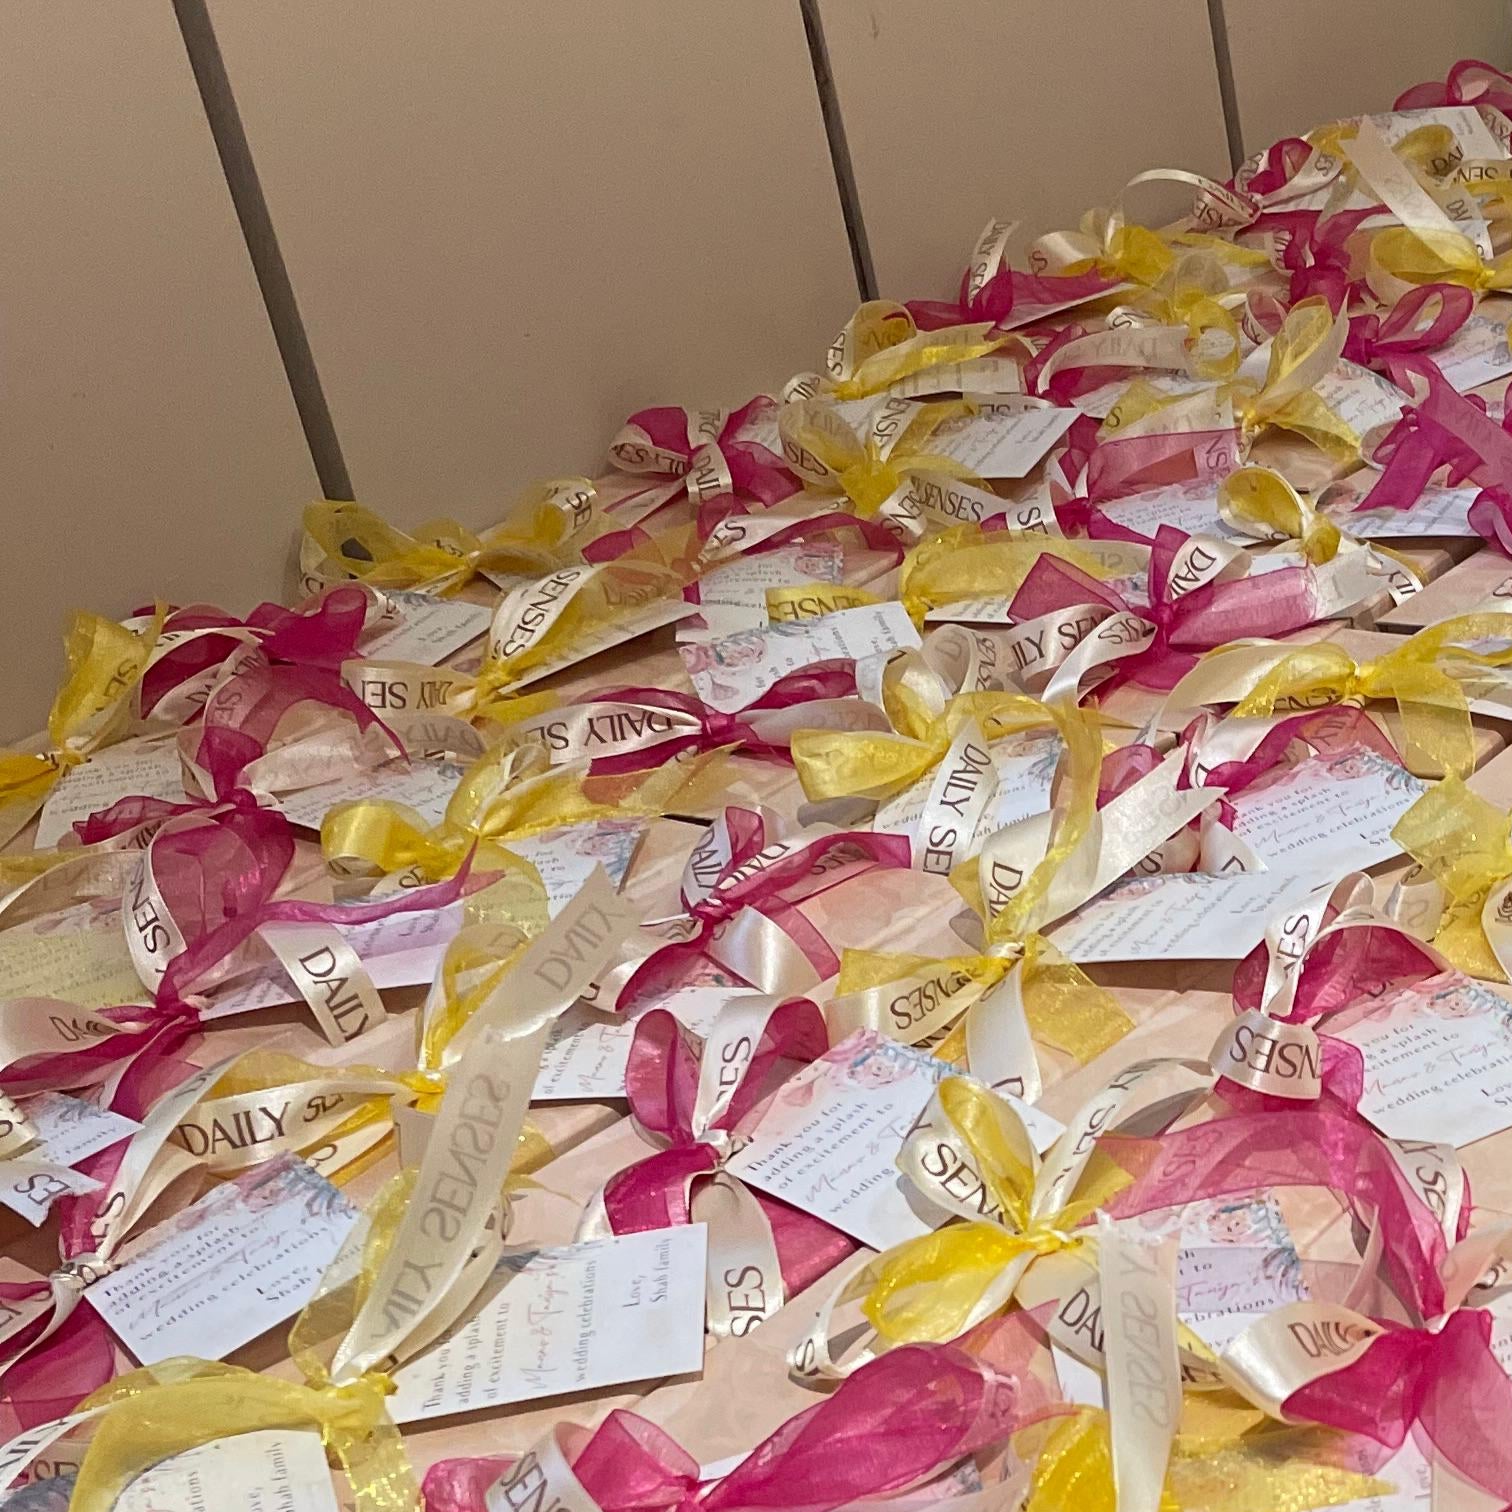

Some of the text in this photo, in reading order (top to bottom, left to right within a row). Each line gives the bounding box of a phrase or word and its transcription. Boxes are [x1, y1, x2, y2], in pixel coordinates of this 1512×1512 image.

[937, 742, 993, 819] DAILY
[179, 1101, 292, 1157] DAILY
[1373, 1084, 1443, 1115] wedding
[747, 1102, 843, 1172] Thank you for
[763, 1101, 869, 1183] adding splash
[778, 1102, 894, 1190] of excitement to
[828, 1166, 896, 1213] wedding
[622, 1274, 649, 1307] Love,
[649, 1237, 673, 1303] Shah family
[575, 1259, 598, 1382] wedding celebrations
[272, 1440, 288, 1482] family
